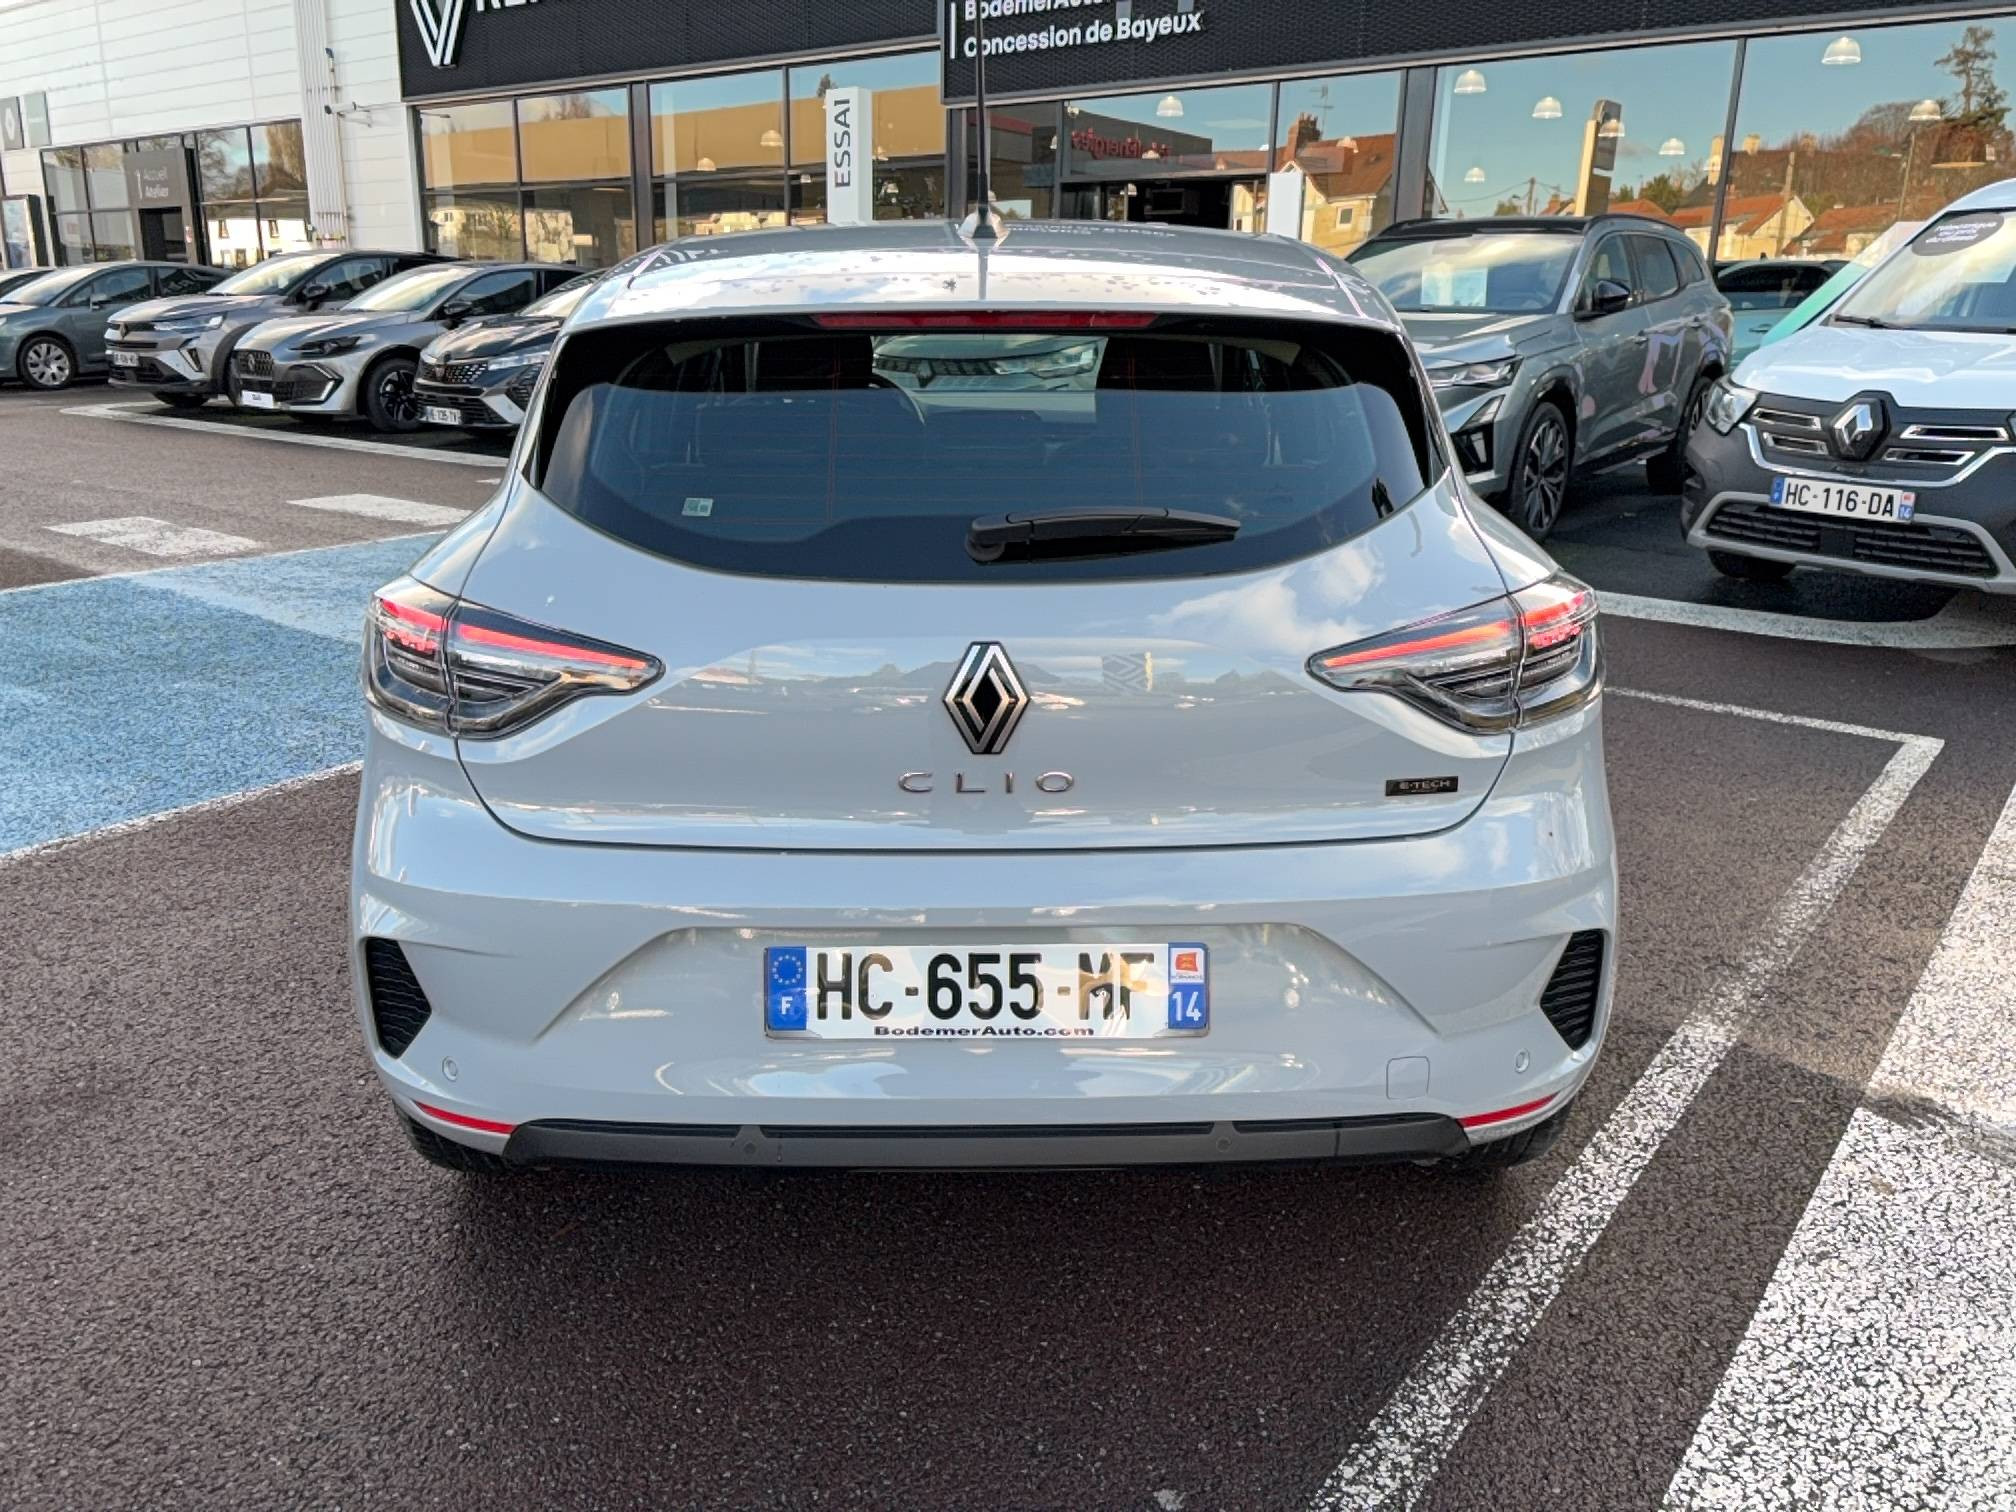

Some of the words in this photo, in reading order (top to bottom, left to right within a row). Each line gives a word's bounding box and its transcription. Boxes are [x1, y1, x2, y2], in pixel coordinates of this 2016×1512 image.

[963, 25, 1081, 58] Concession
[1085, 20, 1113, 44] de
[1116, 12, 1201, 42] Bayeux
[834, 98, 850, 188] ESSAI
[1785, 482, 1894, 517] HC-116-DA
[898, 771, 1075, 794] CLIO
[781, 996, 793, 1015] F
[1172, 991, 1202, 1021] 14
[873, 1025, 1095, 1036] BodemerAuto.com
